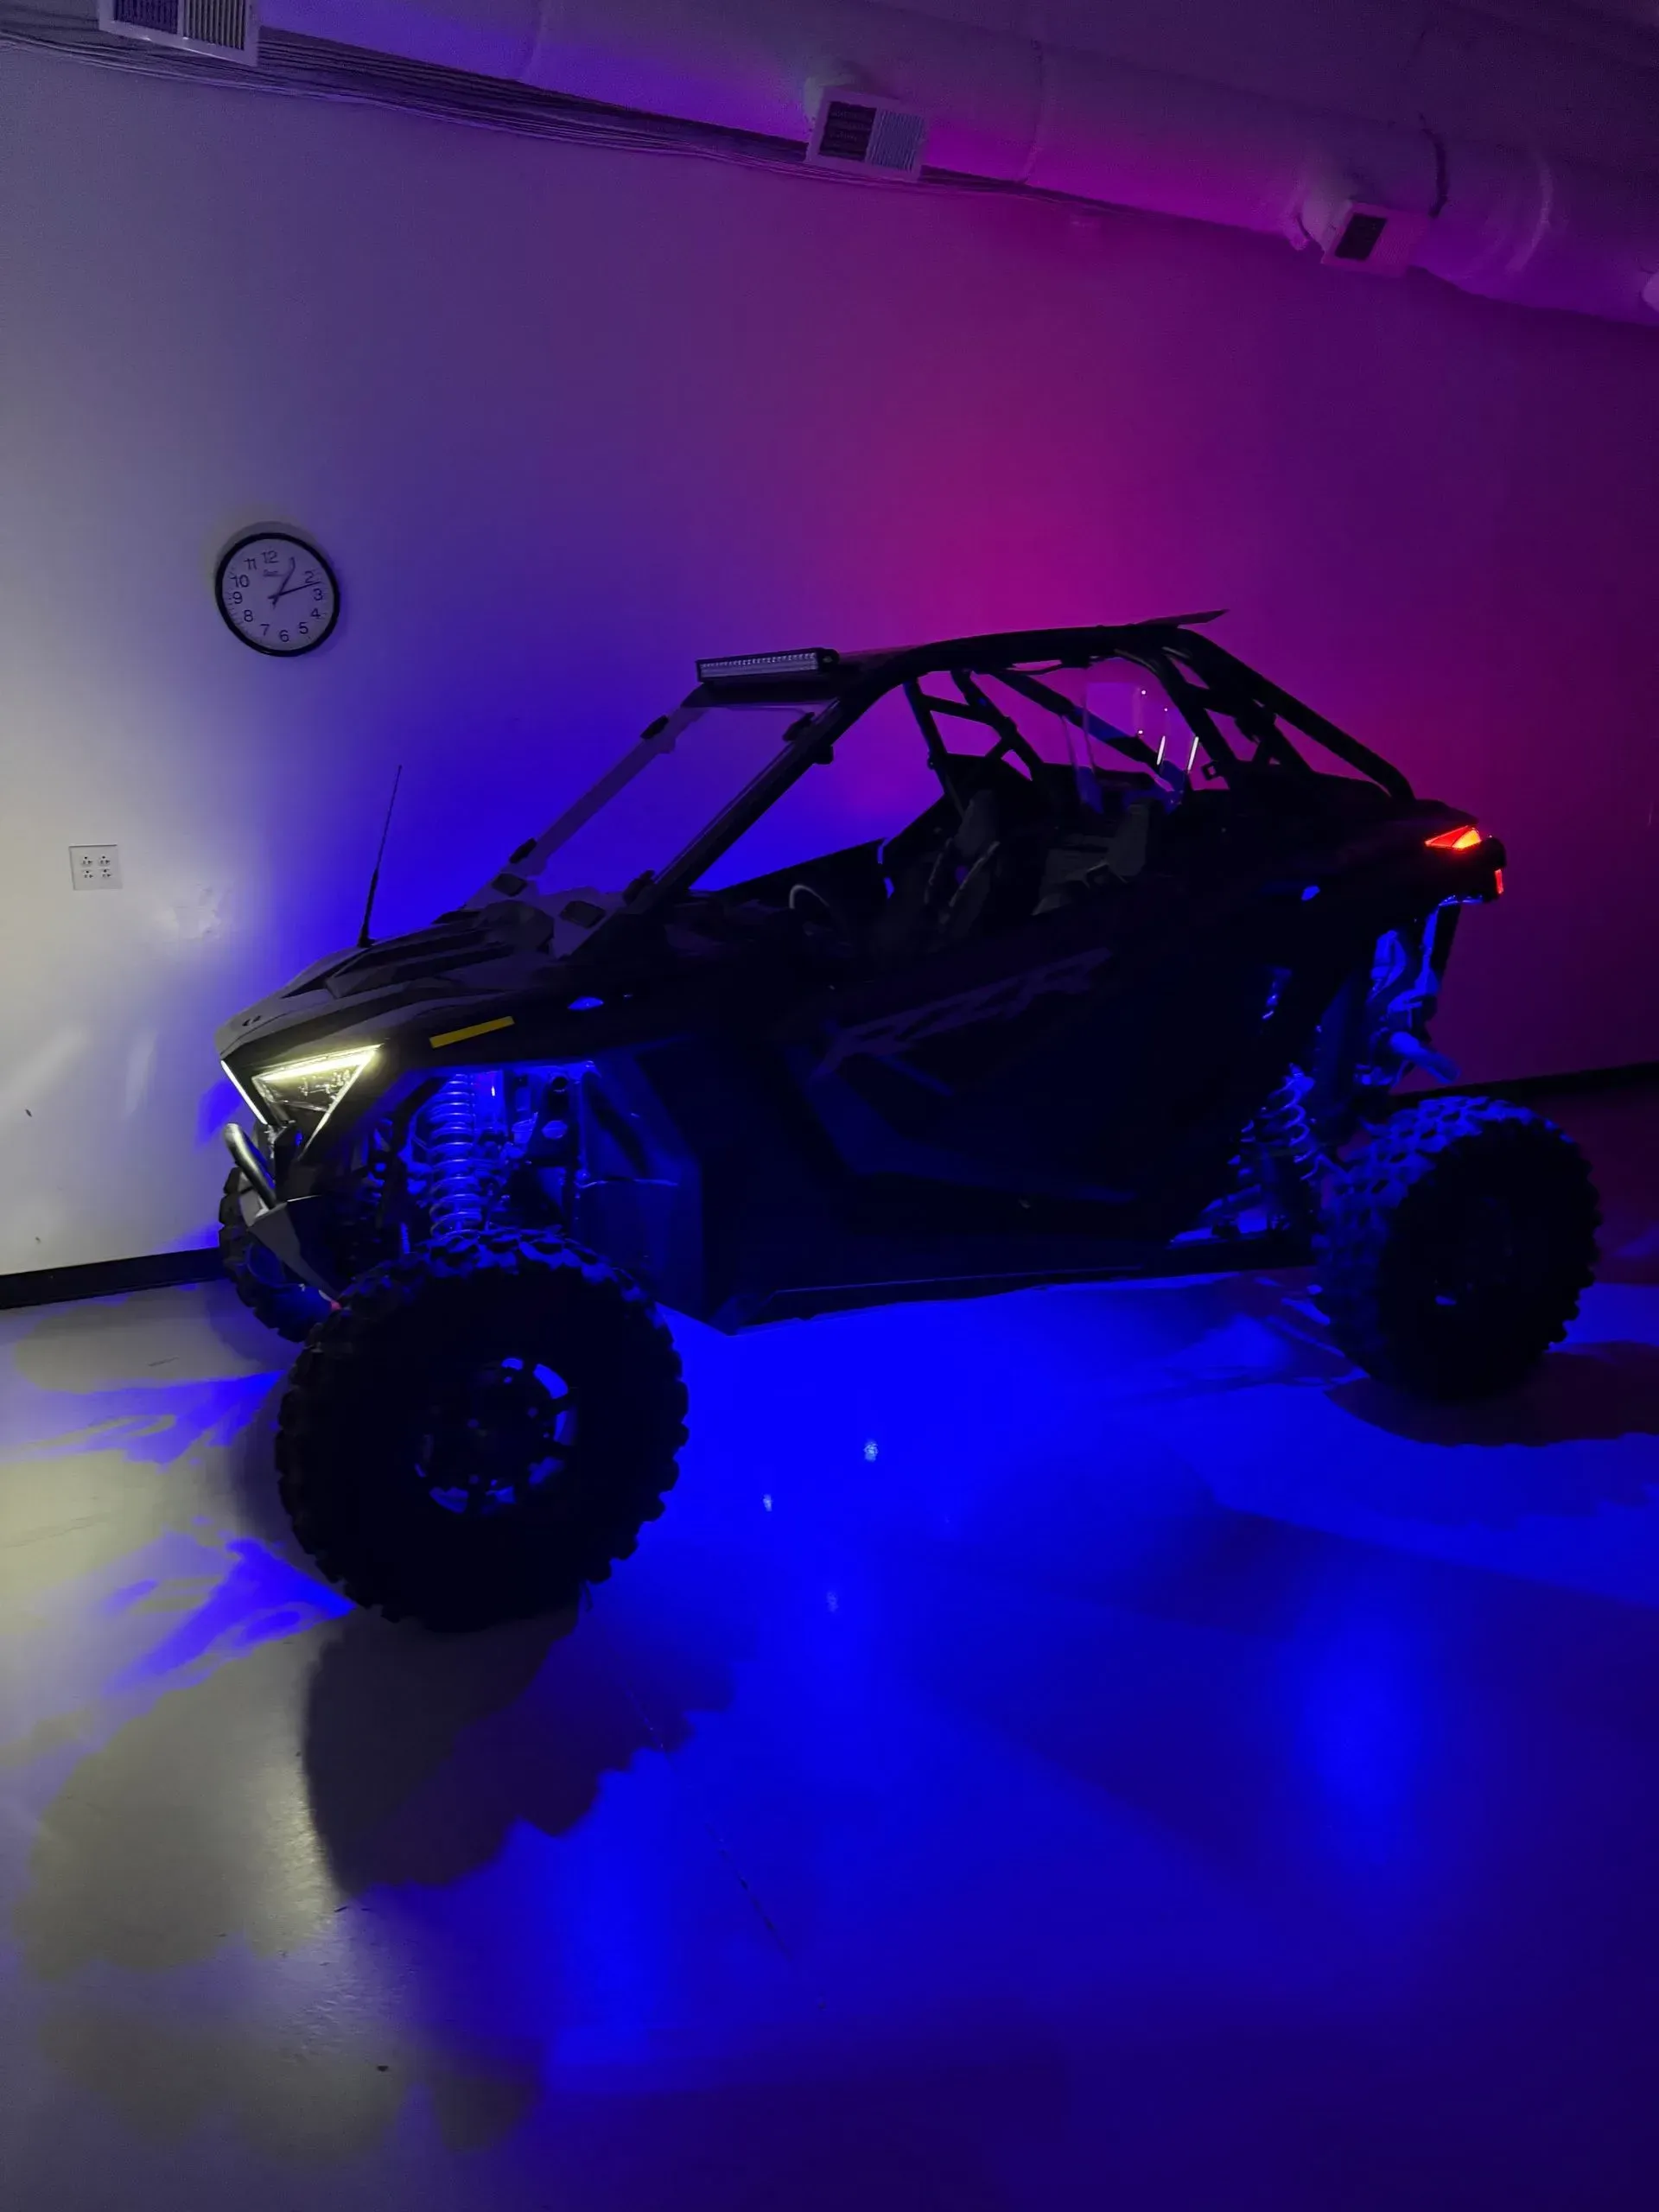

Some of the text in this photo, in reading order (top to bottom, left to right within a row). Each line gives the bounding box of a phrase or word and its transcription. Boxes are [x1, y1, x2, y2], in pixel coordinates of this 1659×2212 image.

[261, 550, 279, 563] 12
[244, 558, 257, 570] 11
[230, 575, 250, 588] 10
[304, 570, 314, 583] 2
[232, 591, 243, 604] 9
[313, 588, 323, 601] 3
[244, 609, 253, 622] 8
[310, 608, 321, 620] 4
[260, 623, 270, 636] 7
[299, 622, 308, 634] 5
[279, 629, 289, 642] 6
